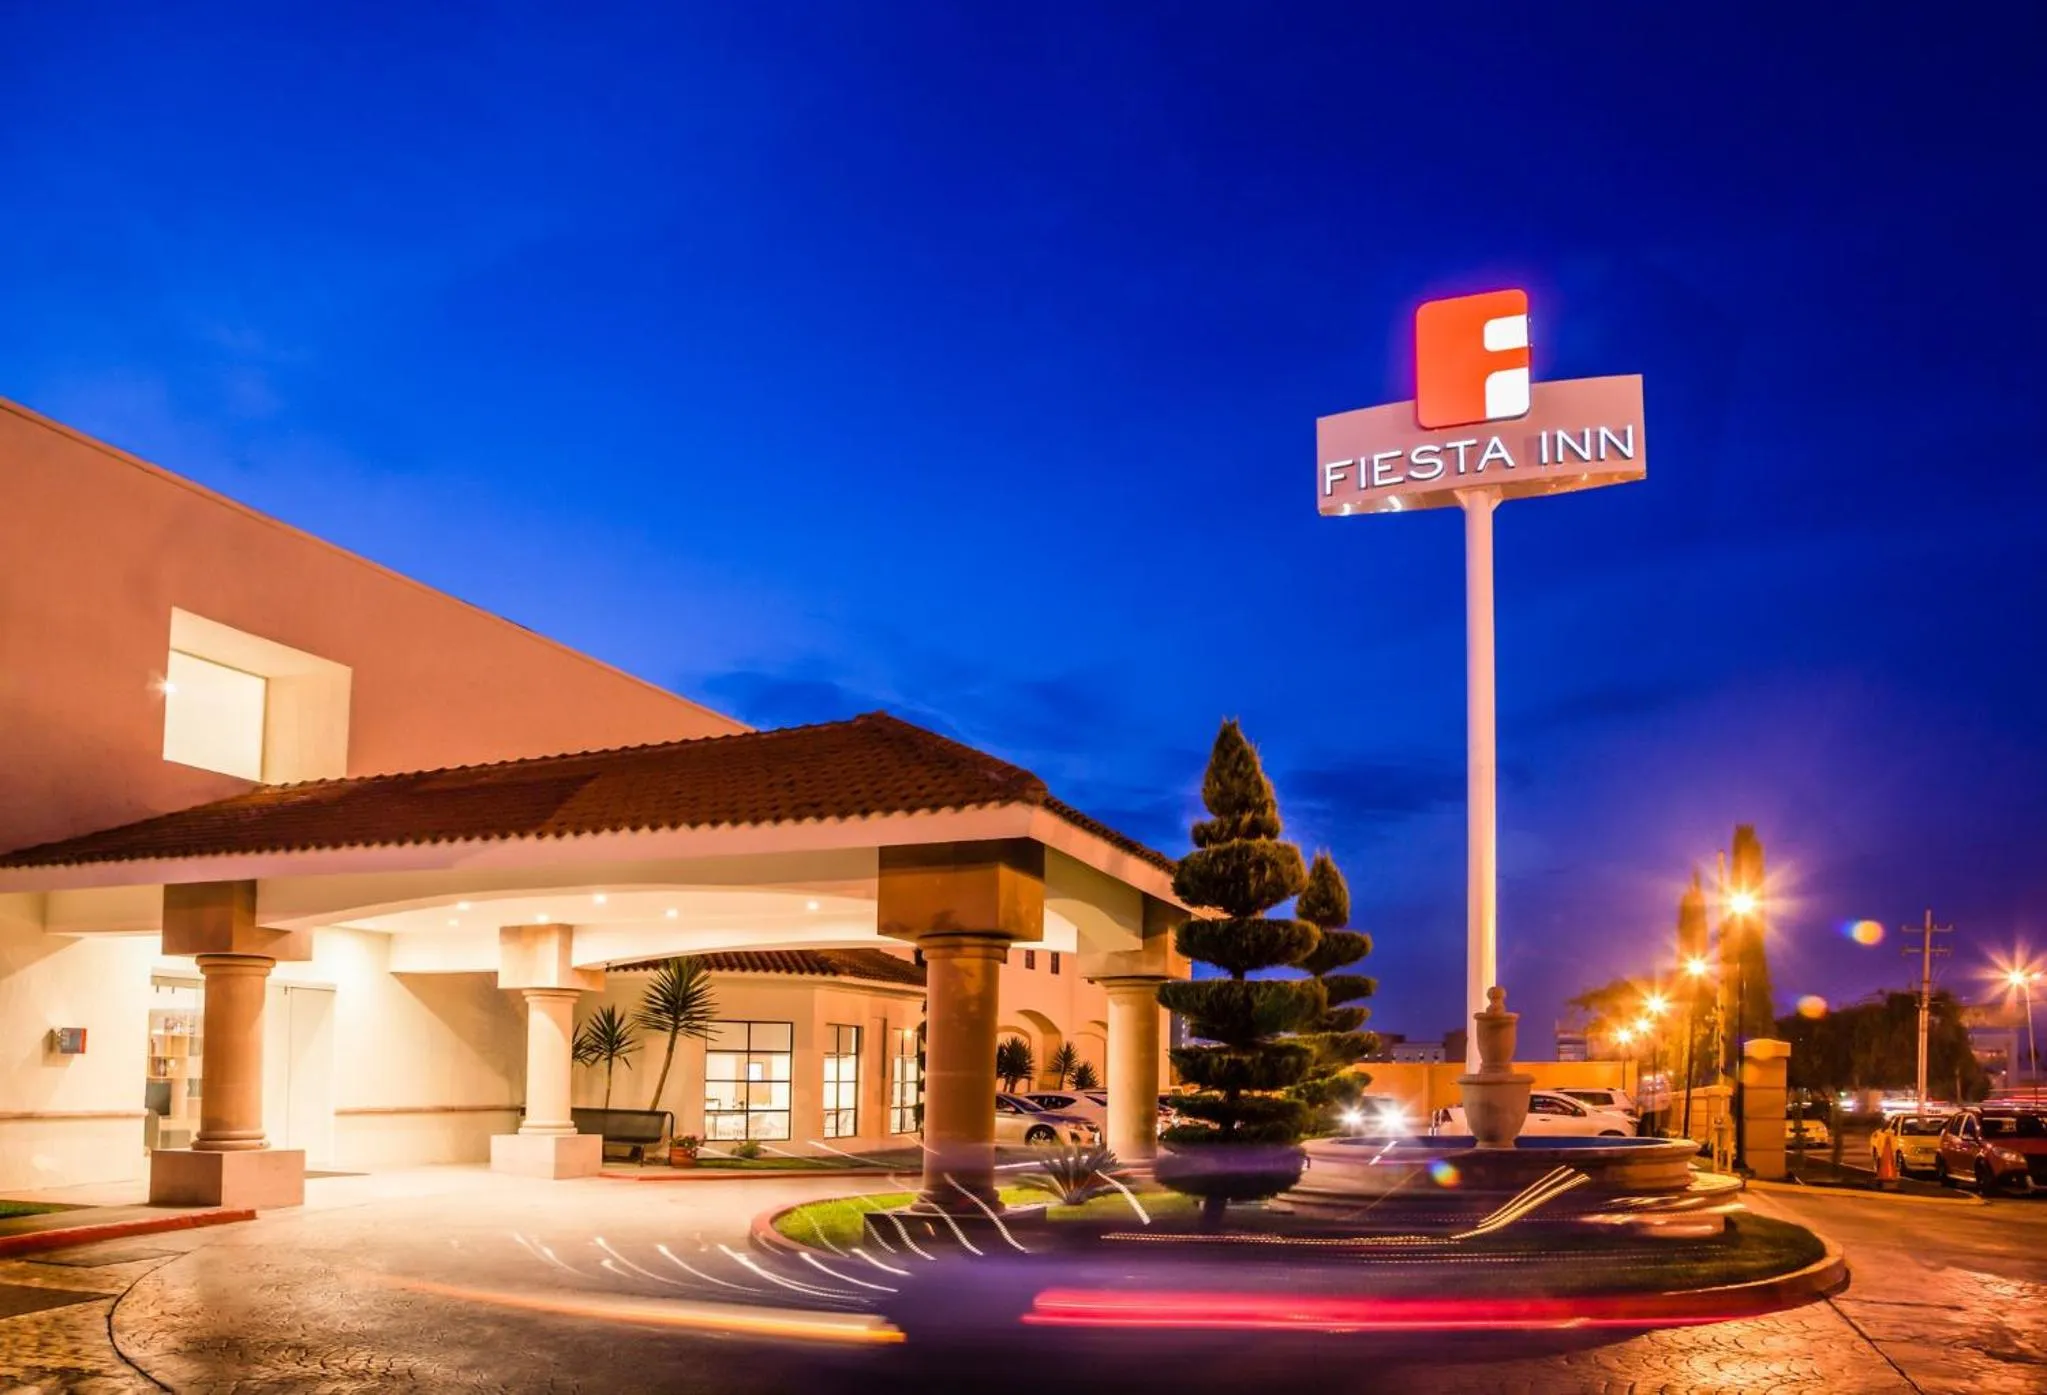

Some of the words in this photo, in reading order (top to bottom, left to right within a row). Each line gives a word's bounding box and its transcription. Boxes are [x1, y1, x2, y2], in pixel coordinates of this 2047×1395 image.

[1416, 289, 1530, 429] F
[1324, 437, 1515, 496] FIESTA
[1540, 425, 1634, 465] INN
